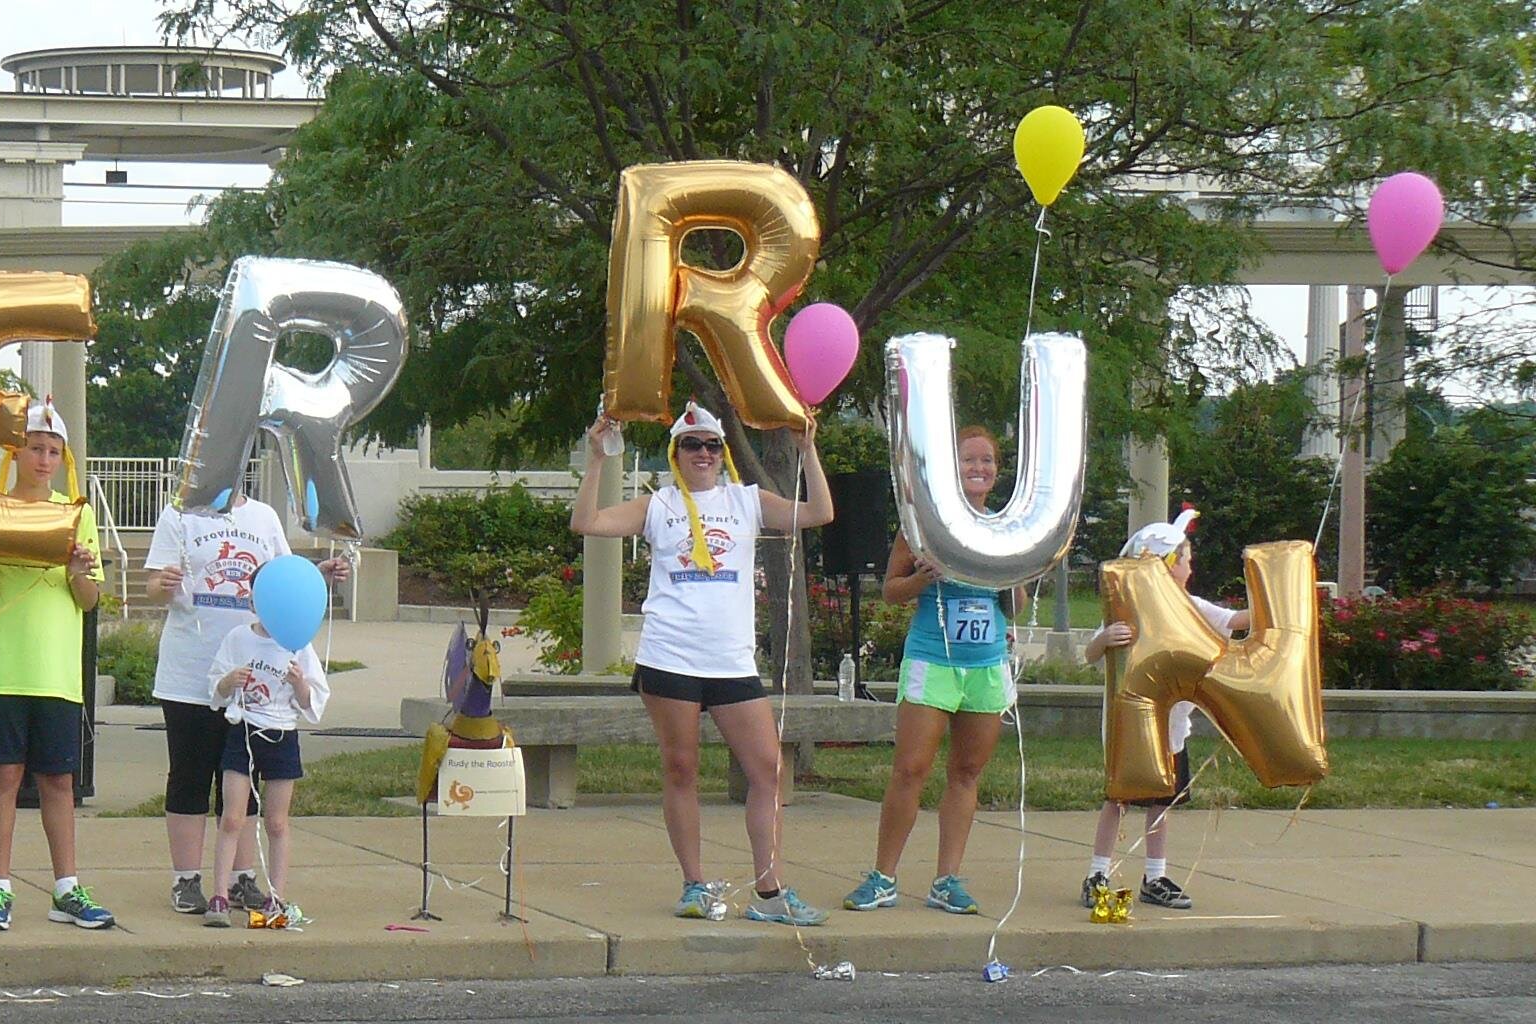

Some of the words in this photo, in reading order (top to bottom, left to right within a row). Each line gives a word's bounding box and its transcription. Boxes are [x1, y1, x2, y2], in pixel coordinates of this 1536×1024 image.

[956, 619, 990, 641] 767
[448, 759, 470, 769] Rudy
[471, 759, 485, 768] the
